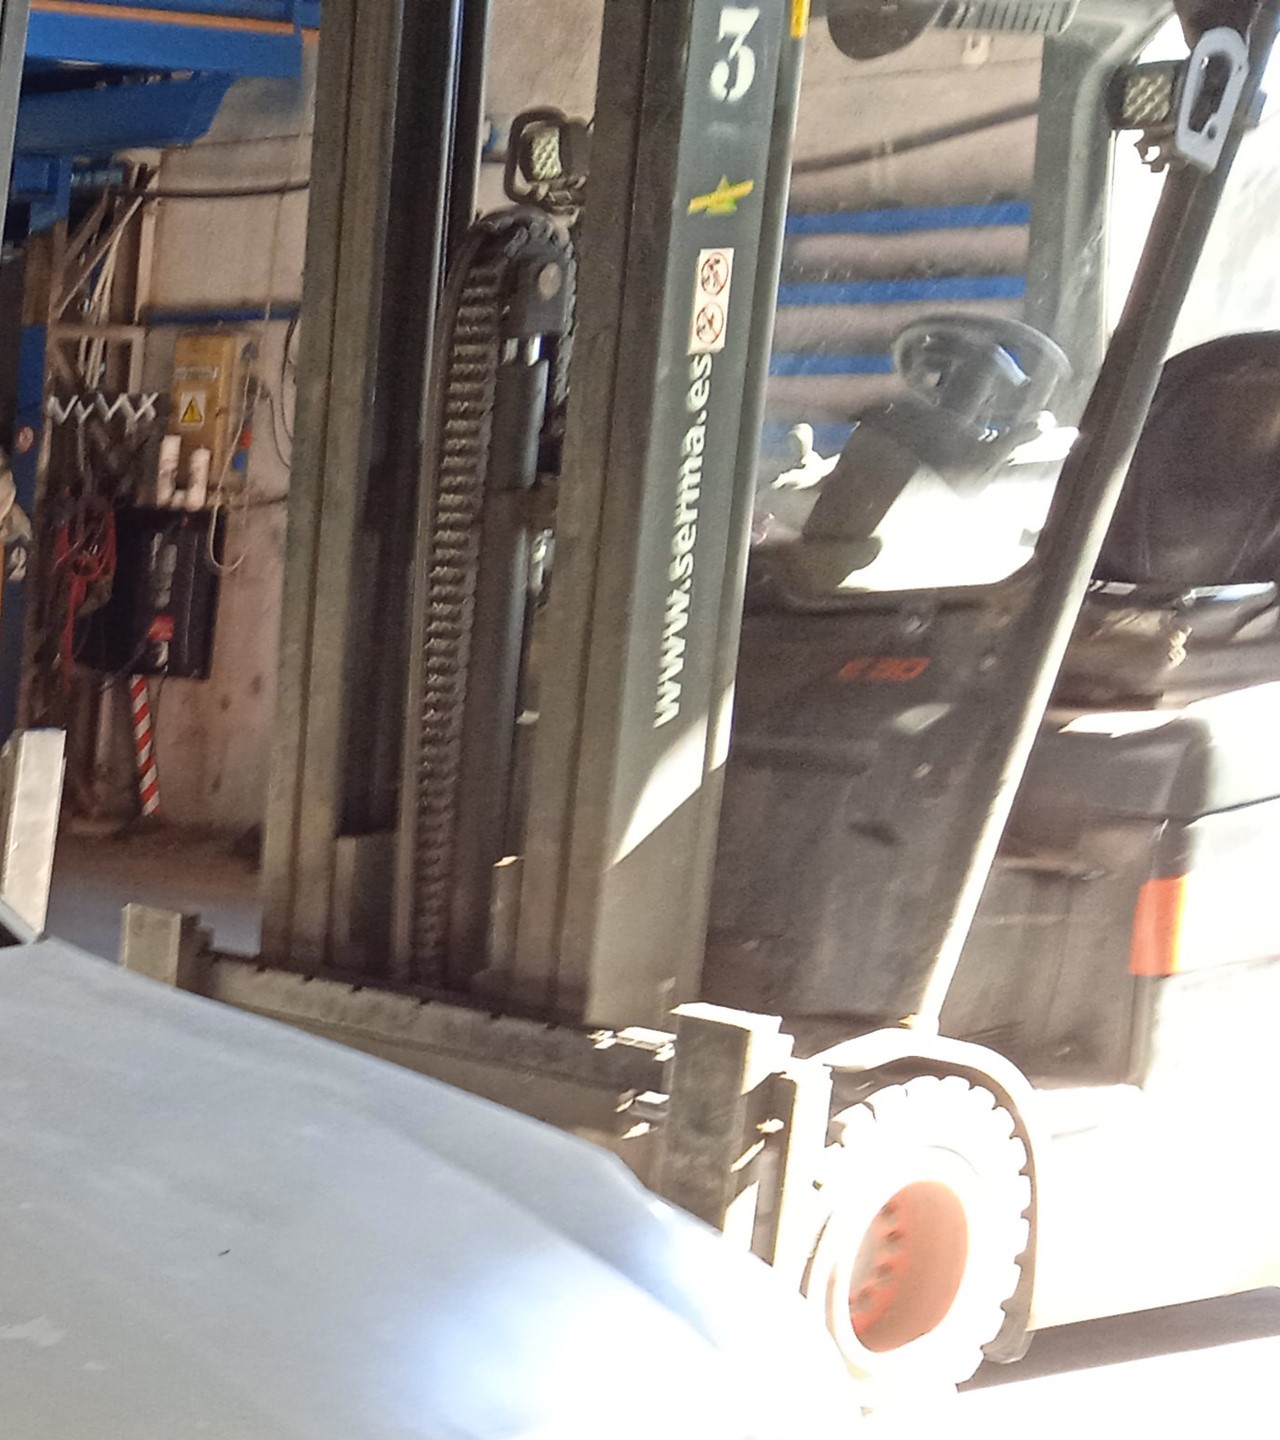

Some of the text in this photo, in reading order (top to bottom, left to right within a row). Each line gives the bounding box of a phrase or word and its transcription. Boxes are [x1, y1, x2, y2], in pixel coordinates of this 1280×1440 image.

[709, 7, 760, 103] 3
[8, 546, 28, 581] 2
[652, 353, 713, 729] www.serma.es
